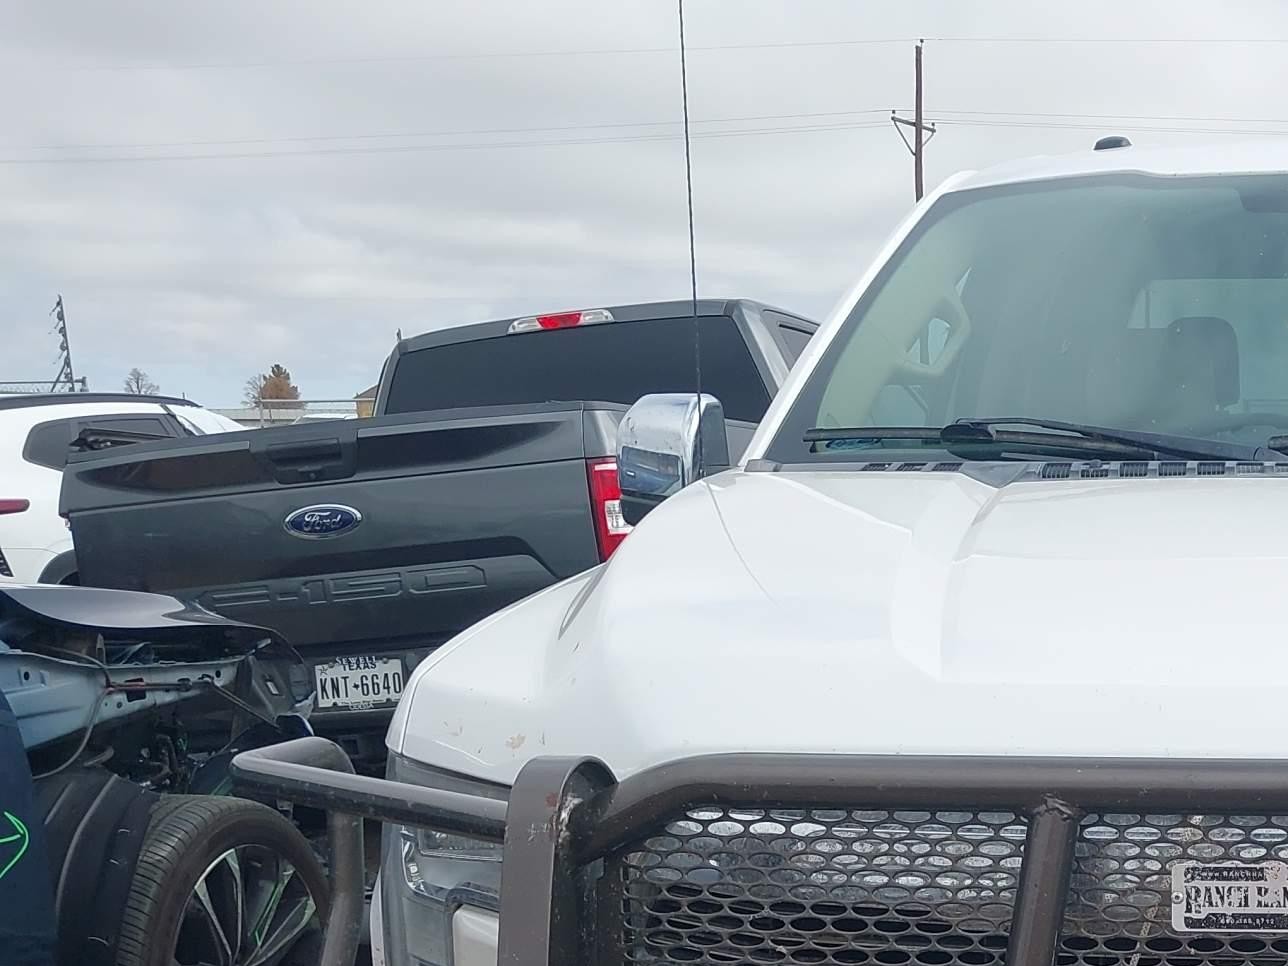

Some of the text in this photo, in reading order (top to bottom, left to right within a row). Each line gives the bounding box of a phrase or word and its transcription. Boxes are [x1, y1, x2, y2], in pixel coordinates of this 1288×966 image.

[302, 511, 343, 531] Ford
[201, 564, 487, 607] F-150
[342, 662, 377, 672] TEXAS
[319, 671, 402, 700] KNT 6640
[1184, 885, 1250, 914] RANCH
